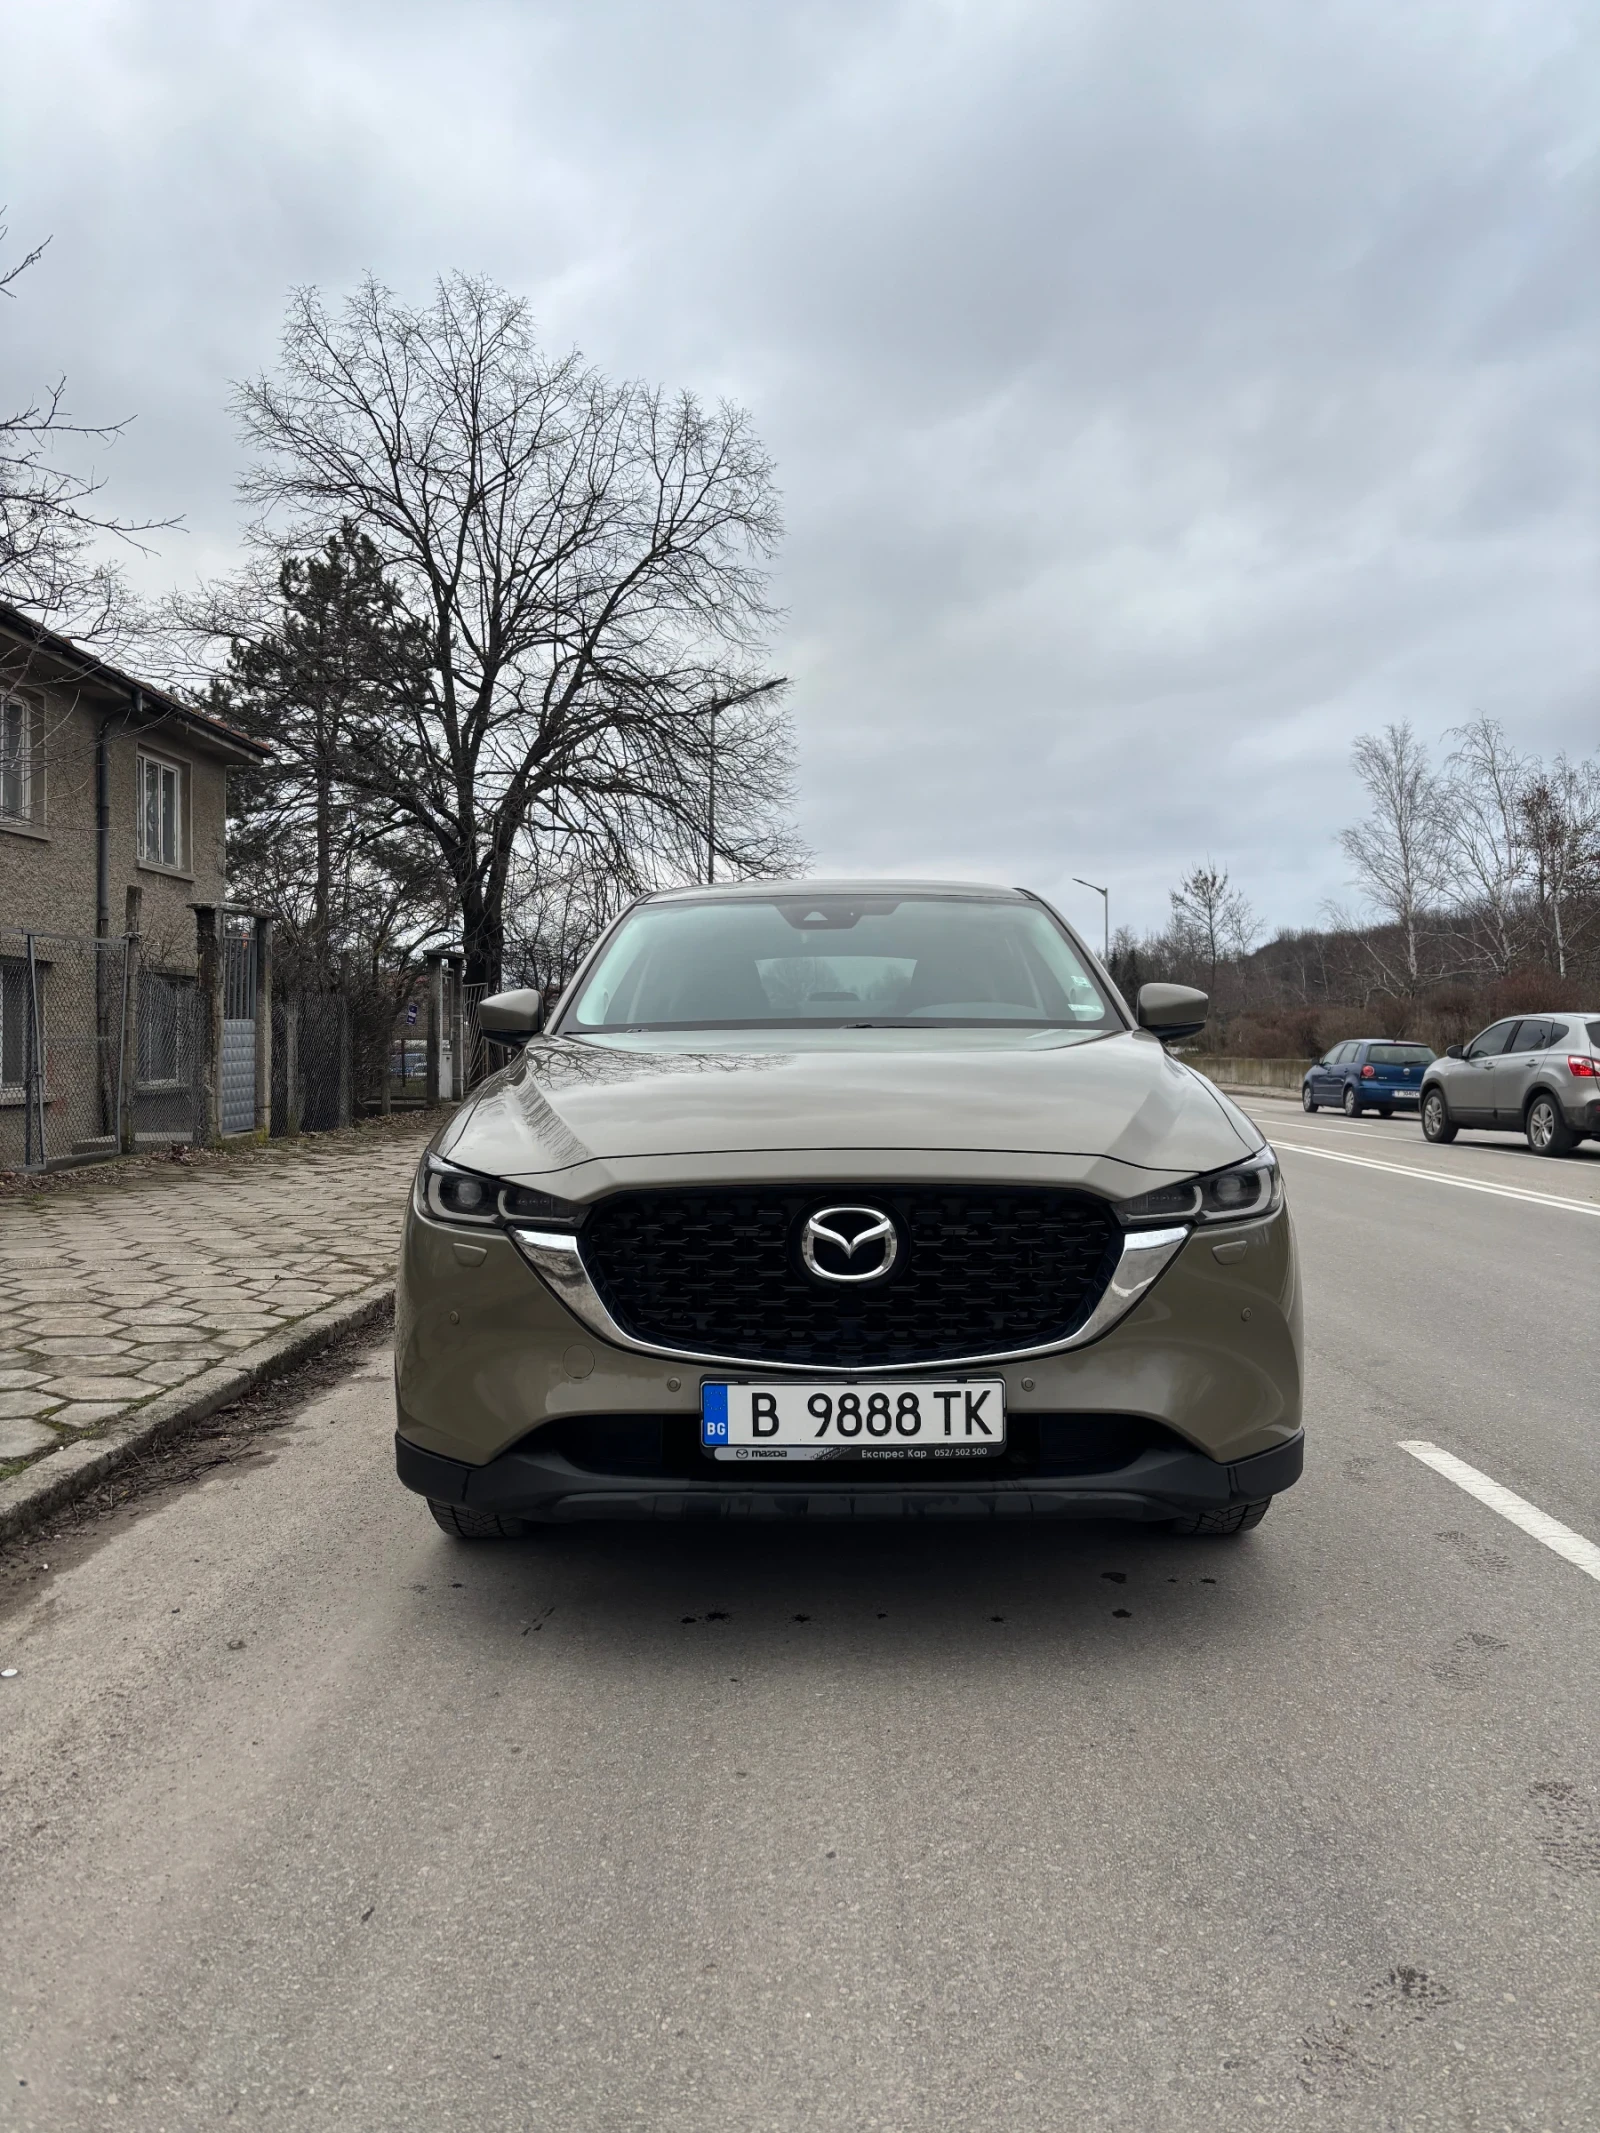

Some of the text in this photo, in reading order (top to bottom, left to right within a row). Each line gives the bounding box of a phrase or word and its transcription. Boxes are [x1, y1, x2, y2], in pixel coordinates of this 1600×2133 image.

[751, 1390, 993, 1438] B 9888 TK
[707, 1422, 726, 1436] BG
[751, 1448, 788, 1458] mazda
[861, 1449, 905, 1459] Експрес
[907, 1449, 927, 1459] Кар
[934, 1448, 954, 1457] 052/
[955, 1448, 971, 1456] 502
[972, 1447, 988, 1456] 500
